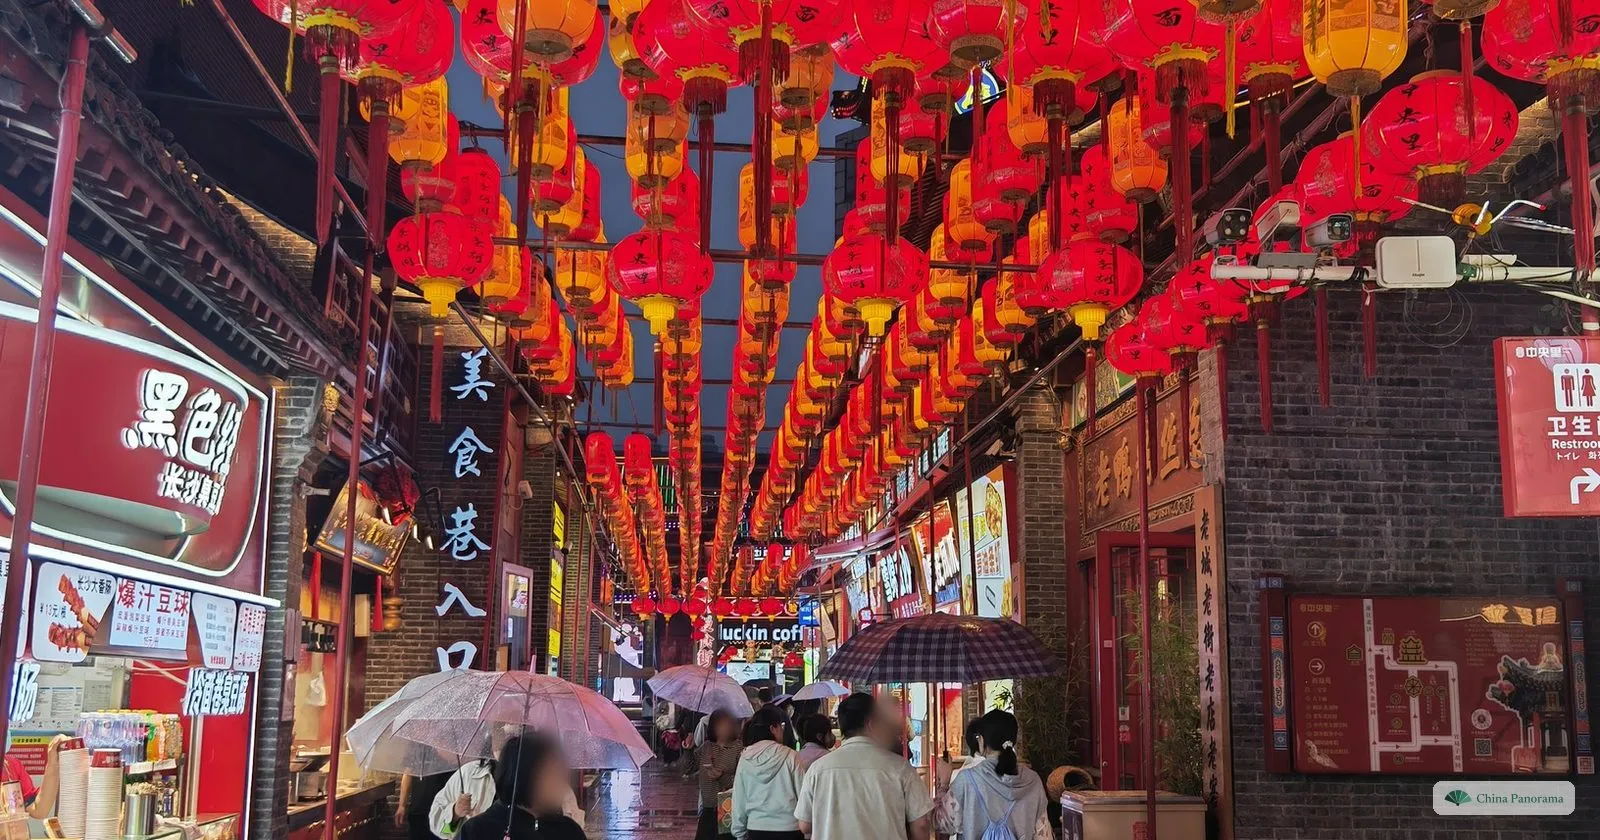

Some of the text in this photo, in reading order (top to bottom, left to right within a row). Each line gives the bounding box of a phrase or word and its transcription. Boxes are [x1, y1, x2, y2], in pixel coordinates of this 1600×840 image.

[1393, 83, 1423, 150] 中央里
[631, 234, 650, 284] 中央里
[1526, 347, 1562, 358] 中央里
[1548, 415, 1600, 436] 卫生
[1552, 439, 1600, 449] Restroo
[1557, 452, 1580, 460] トイレ
[436, 346, 496, 670] 美食巷入口
[78, 575, 112, 594] 长沙大香肠
[117, 578, 189, 617] 爆汁豆球
[718, 624, 768, 640] luckin
